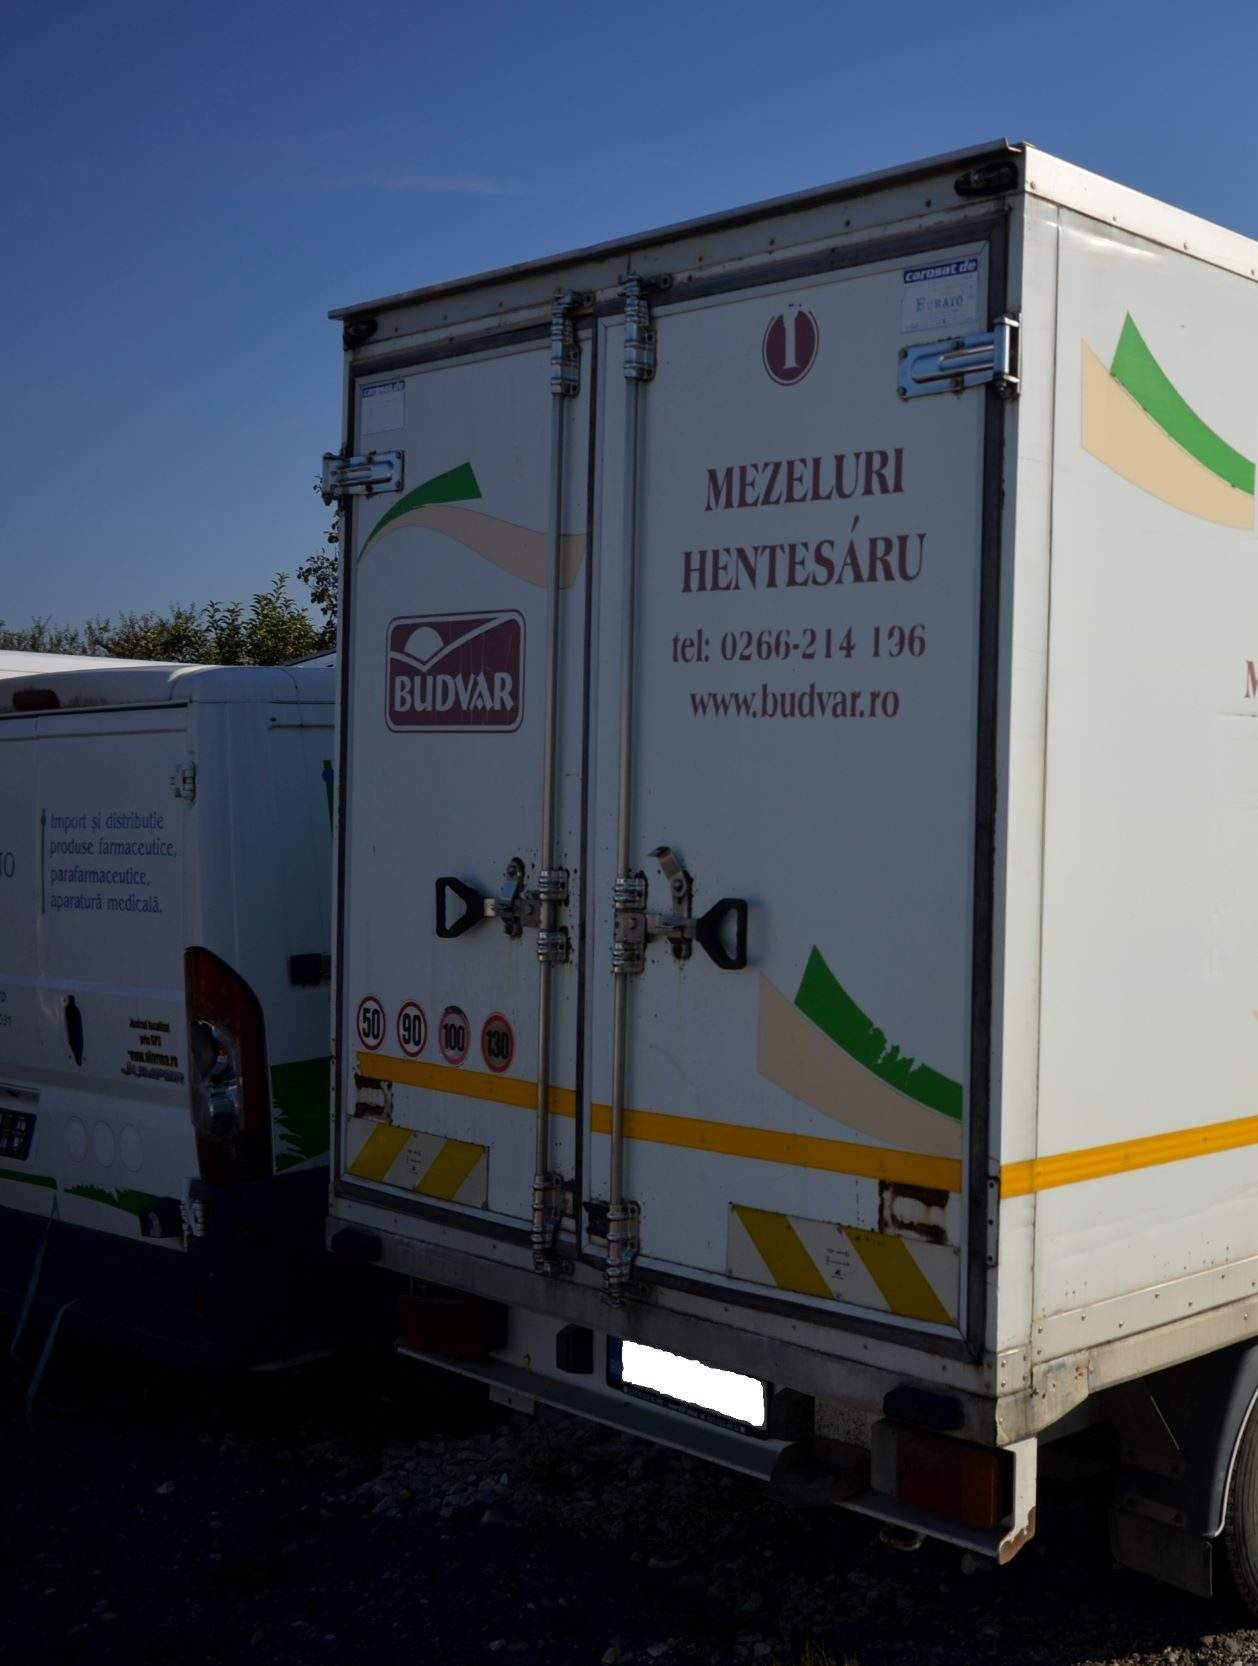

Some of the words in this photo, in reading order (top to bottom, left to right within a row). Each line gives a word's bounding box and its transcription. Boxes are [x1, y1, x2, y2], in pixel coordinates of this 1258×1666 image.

[704, 447, 905, 511] MEZELURI
[681, 515, 927, 593] HENTESÁRU
[671, 627, 710, 664] tel:
[720, 626, 855, 661] 0266-214
[394, 671, 514, 713] BUDVAR
[689, 683, 899, 720] www.budvar.ro
[50, 812, 87, 834] Import
[49, 839, 94, 858] produse
[98, 837, 177, 858] farmaceutice,
[50, 865, 152, 886] parafarmaceutice,
[362, 1007, 381, 1040] 50
[402, 1013, 422, 1047] 90
[443, 1023, 465, 1052] 100
[486, 1029, 509, 1060] 130
